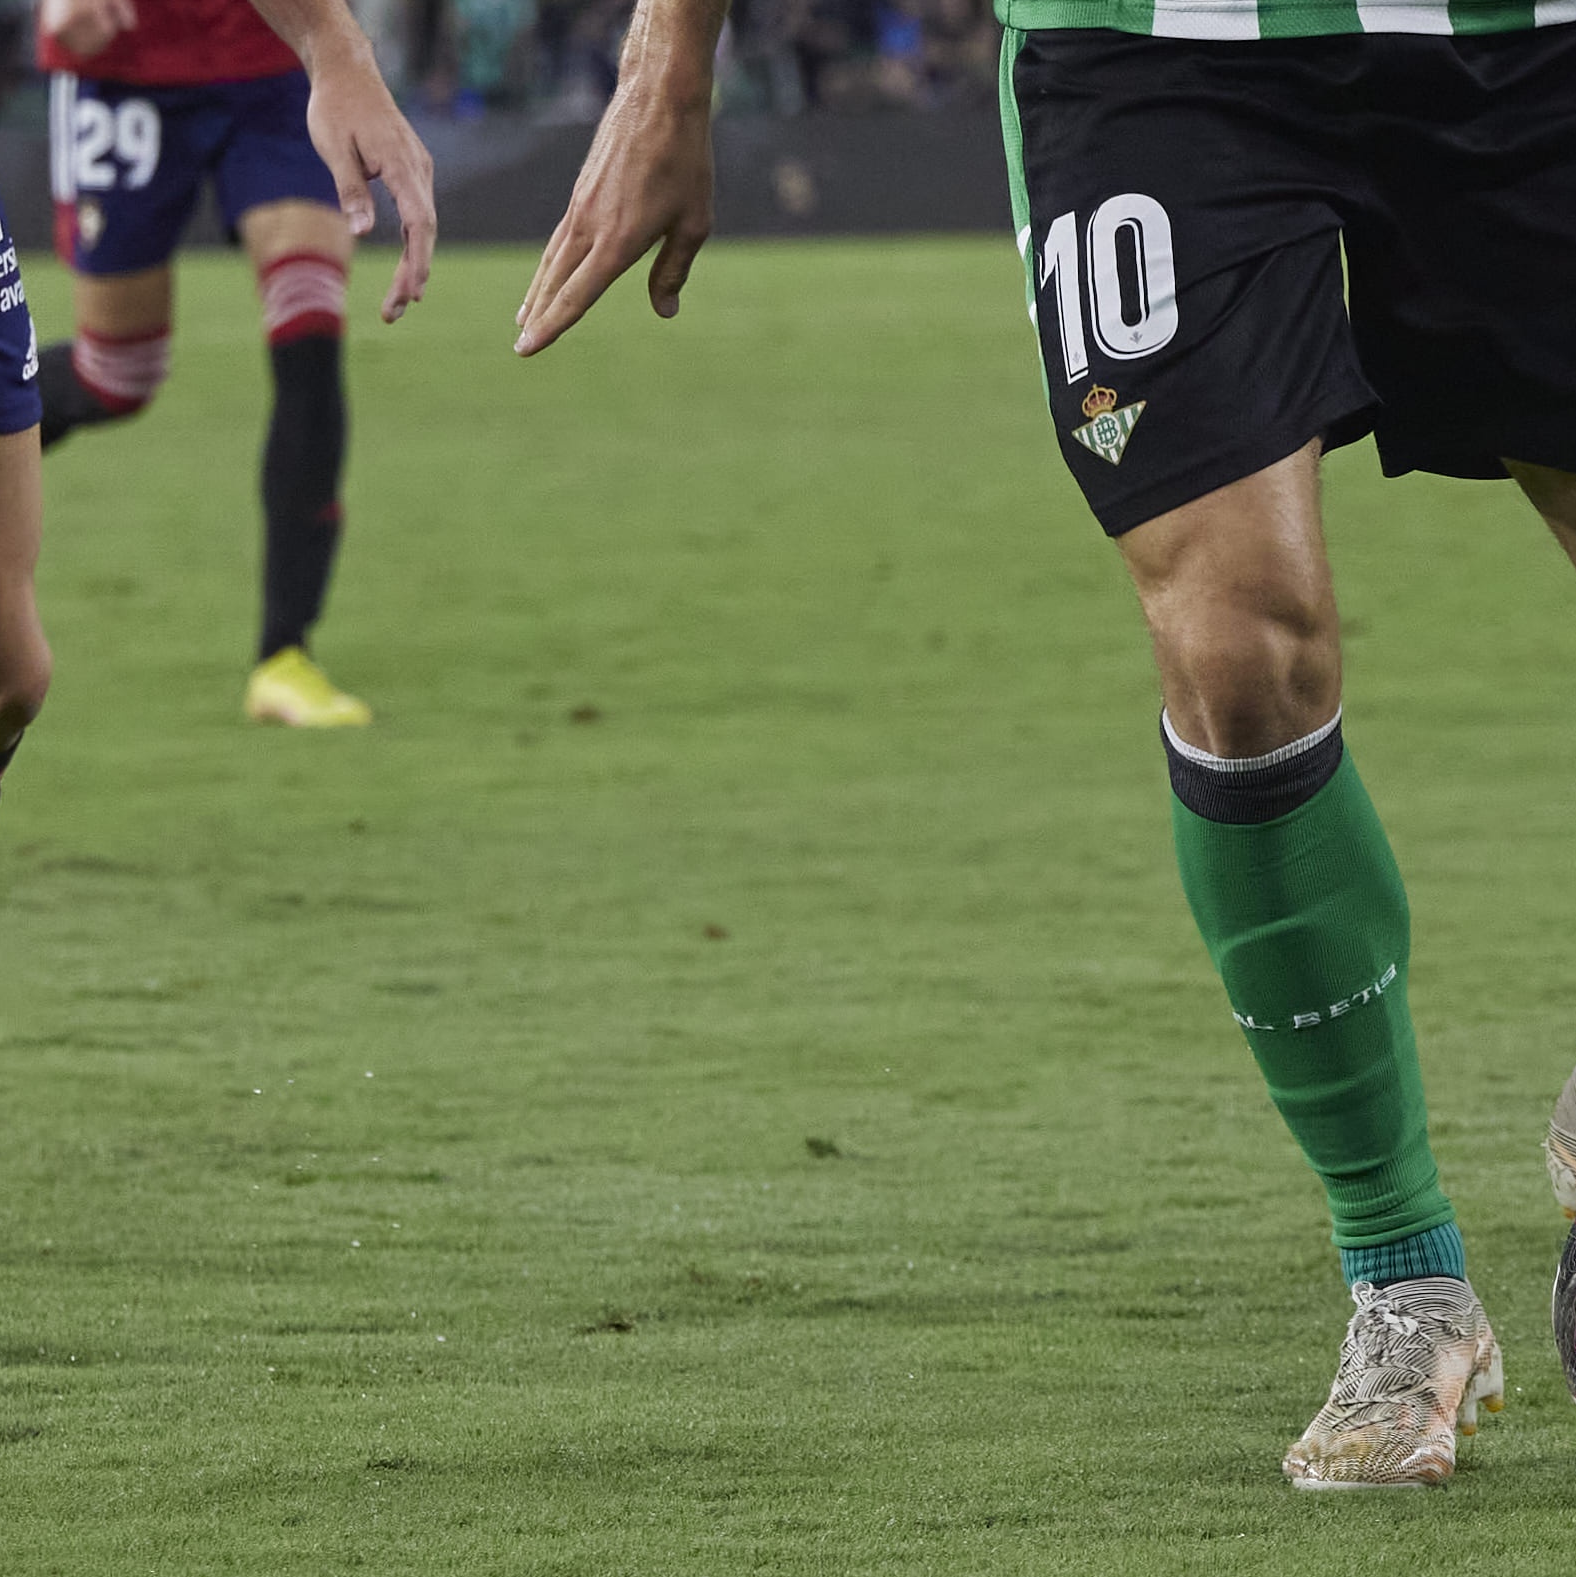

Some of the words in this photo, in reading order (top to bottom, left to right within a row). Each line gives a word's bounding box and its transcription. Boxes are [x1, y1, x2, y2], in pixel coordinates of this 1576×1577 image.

[74, 98, 162, 190] 29
[1039, 193, 1178, 385] 10
[1293, 963, 1397, 1029] BETIS
